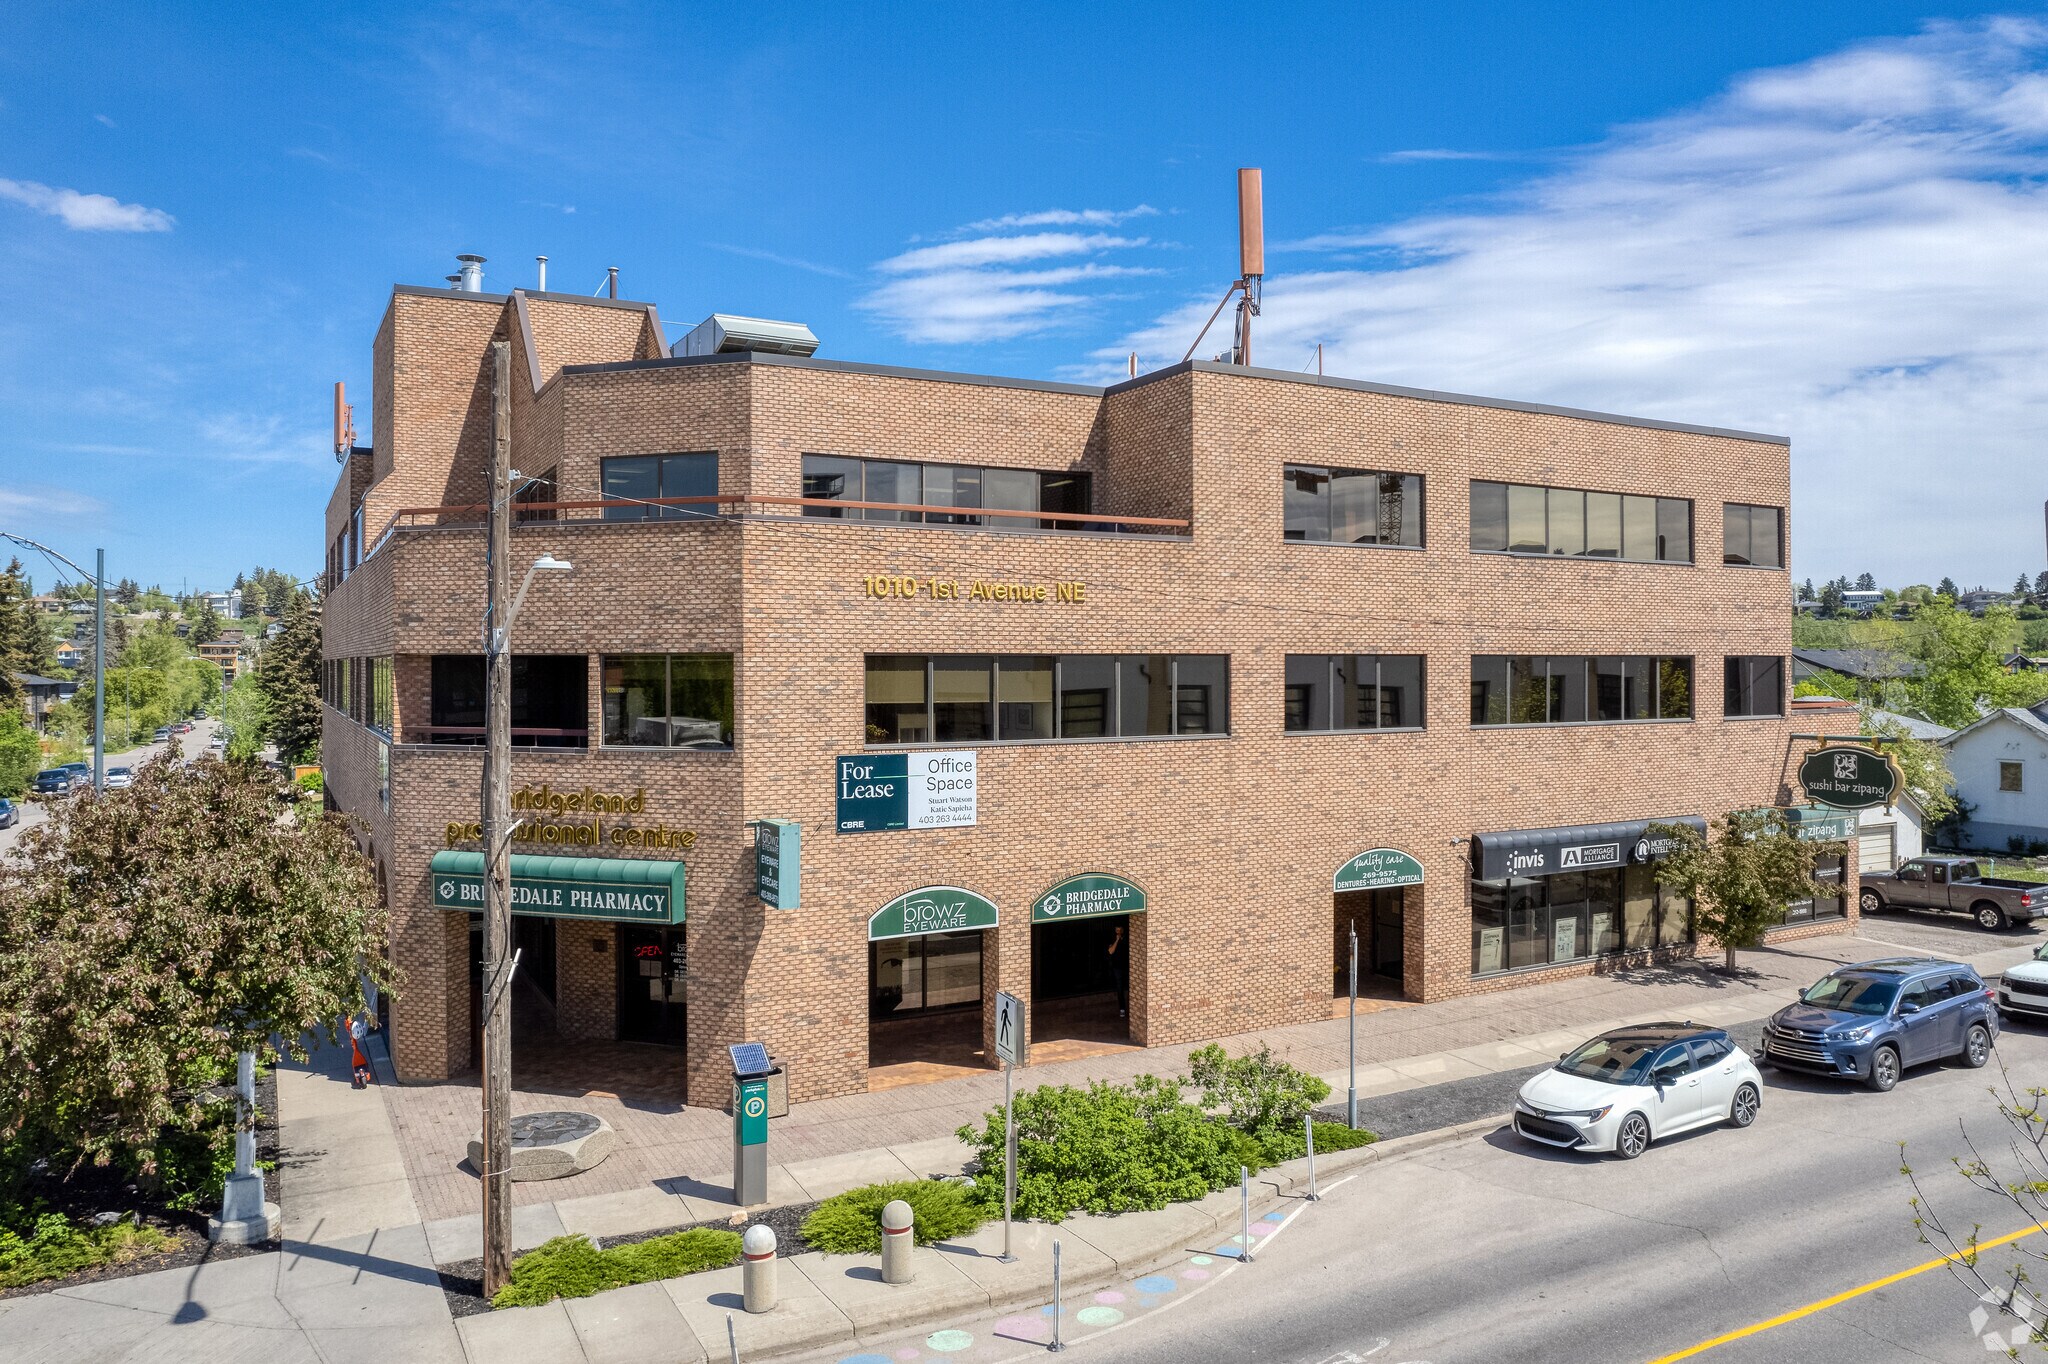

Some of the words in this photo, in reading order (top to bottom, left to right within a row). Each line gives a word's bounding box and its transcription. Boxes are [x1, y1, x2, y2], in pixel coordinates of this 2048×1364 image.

[969, 579, 1047, 603] Avenue
[1056, 582, 1086, 603] NE
[841, 762, 874, 781] For
[928, 758, 973, 774] Office
[841, 781, 894, 799] Lease
[926, 776, 973, 794] Space
[1809, 779, 1833, 791] sushi
[1835, 780, 1851, 793] bar
[1852, 783, 1885, 798] zipang
[511, 784, 646, 817] ridgeland
[841, 820, 865, 829] CBRE
[918, 815, 934, 824] 403
[936, 814, 951, 823] 263
[952, 813, 972, 822] 4444
[445, 816, 600, 847] prossional
[611, 824, 698, 849] centre
[1808, 824, 1837, 839] zipang
[1513, 848, 1544, 869] invis
[1583, 846, 1614, 855] MORTGAGE
[1583, 853, 1614, 862] ALLIANCE
[1354, 853, 1384, 872] quality
[1362, 869, 1398, 879] 269-9575
[460, 883, 563, 906] BRIEDALE
[570, 889, 666, 912] PHARMACY
[1066, 887, 1130, 903] BRIDGEDALE
[903, 898, 967, 922] browz
[1066, 899, 1122, 915] PHARMACY
[903, 916, 967, 933] EYEWARE
